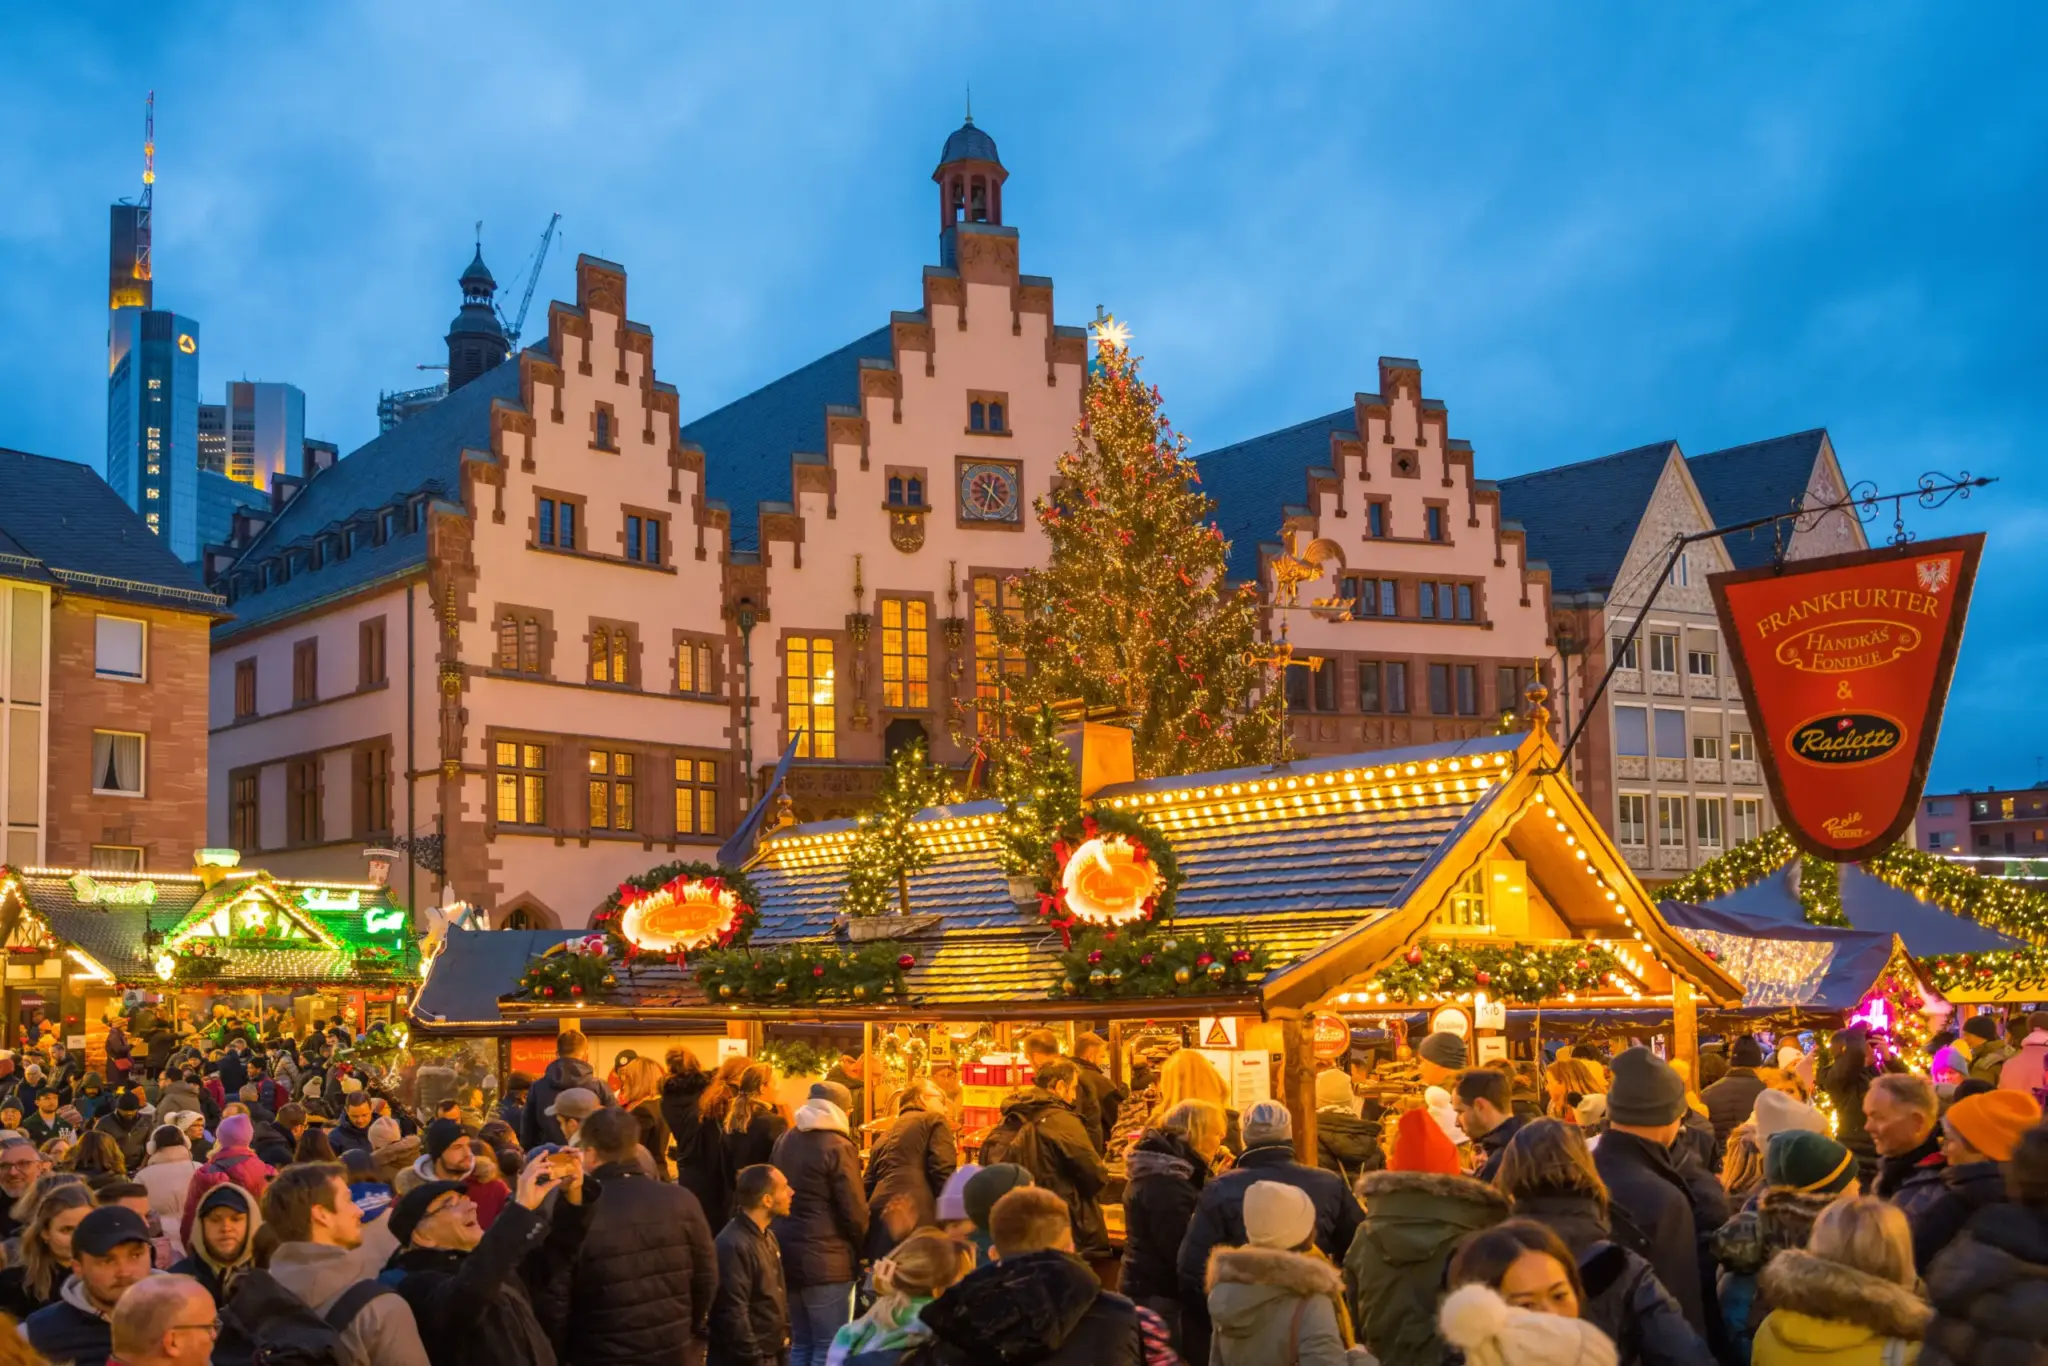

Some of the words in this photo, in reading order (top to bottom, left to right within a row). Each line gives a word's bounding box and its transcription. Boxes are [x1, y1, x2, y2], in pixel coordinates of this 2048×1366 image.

[1756, 588, 1938, 640] FRANKFURTER
[1811, 650, 1882, 670] FONDUE
[1837, 680, 1853, 700] &
[1800, 728, 1895, 753] Raclette
